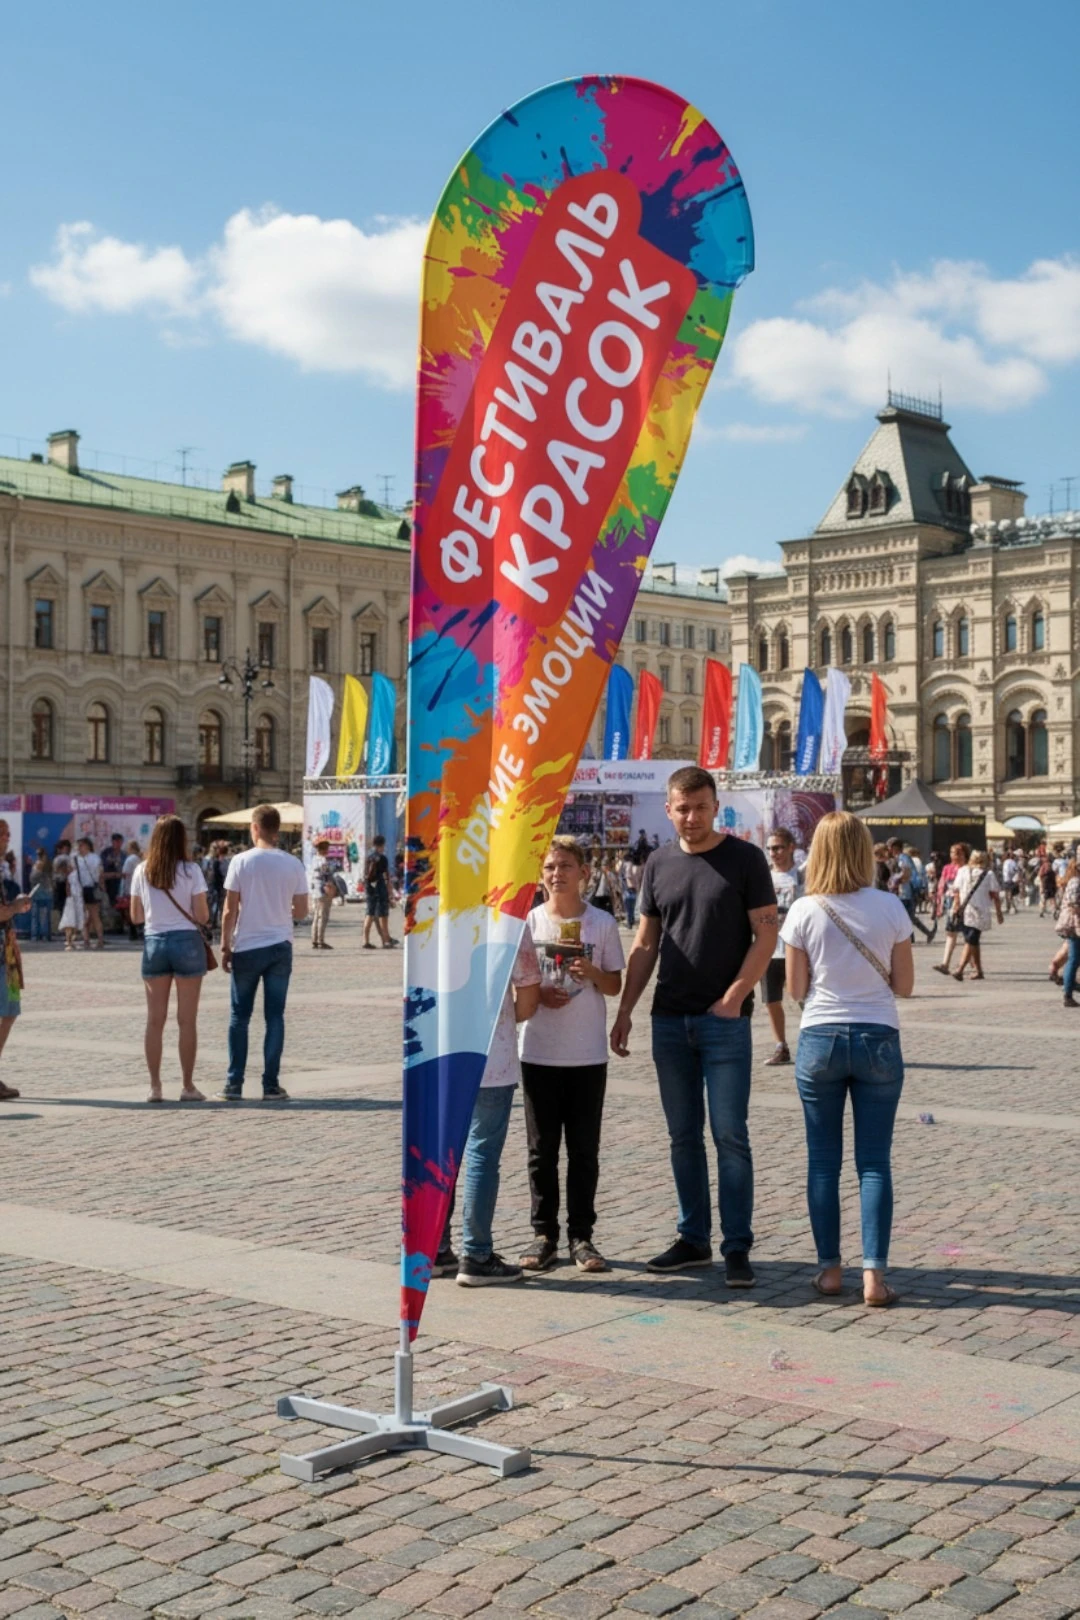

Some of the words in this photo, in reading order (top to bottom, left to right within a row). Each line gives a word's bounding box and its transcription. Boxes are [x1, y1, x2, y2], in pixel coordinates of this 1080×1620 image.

[440, 192, 619, 584] ФЕСТИВАЛЬ
[500, 258, 671, 604] КРАСОК
[456, 744, 525, 875] ЯРКИЕ
[512, 569, 614, 745] ЭМОЦИИ
